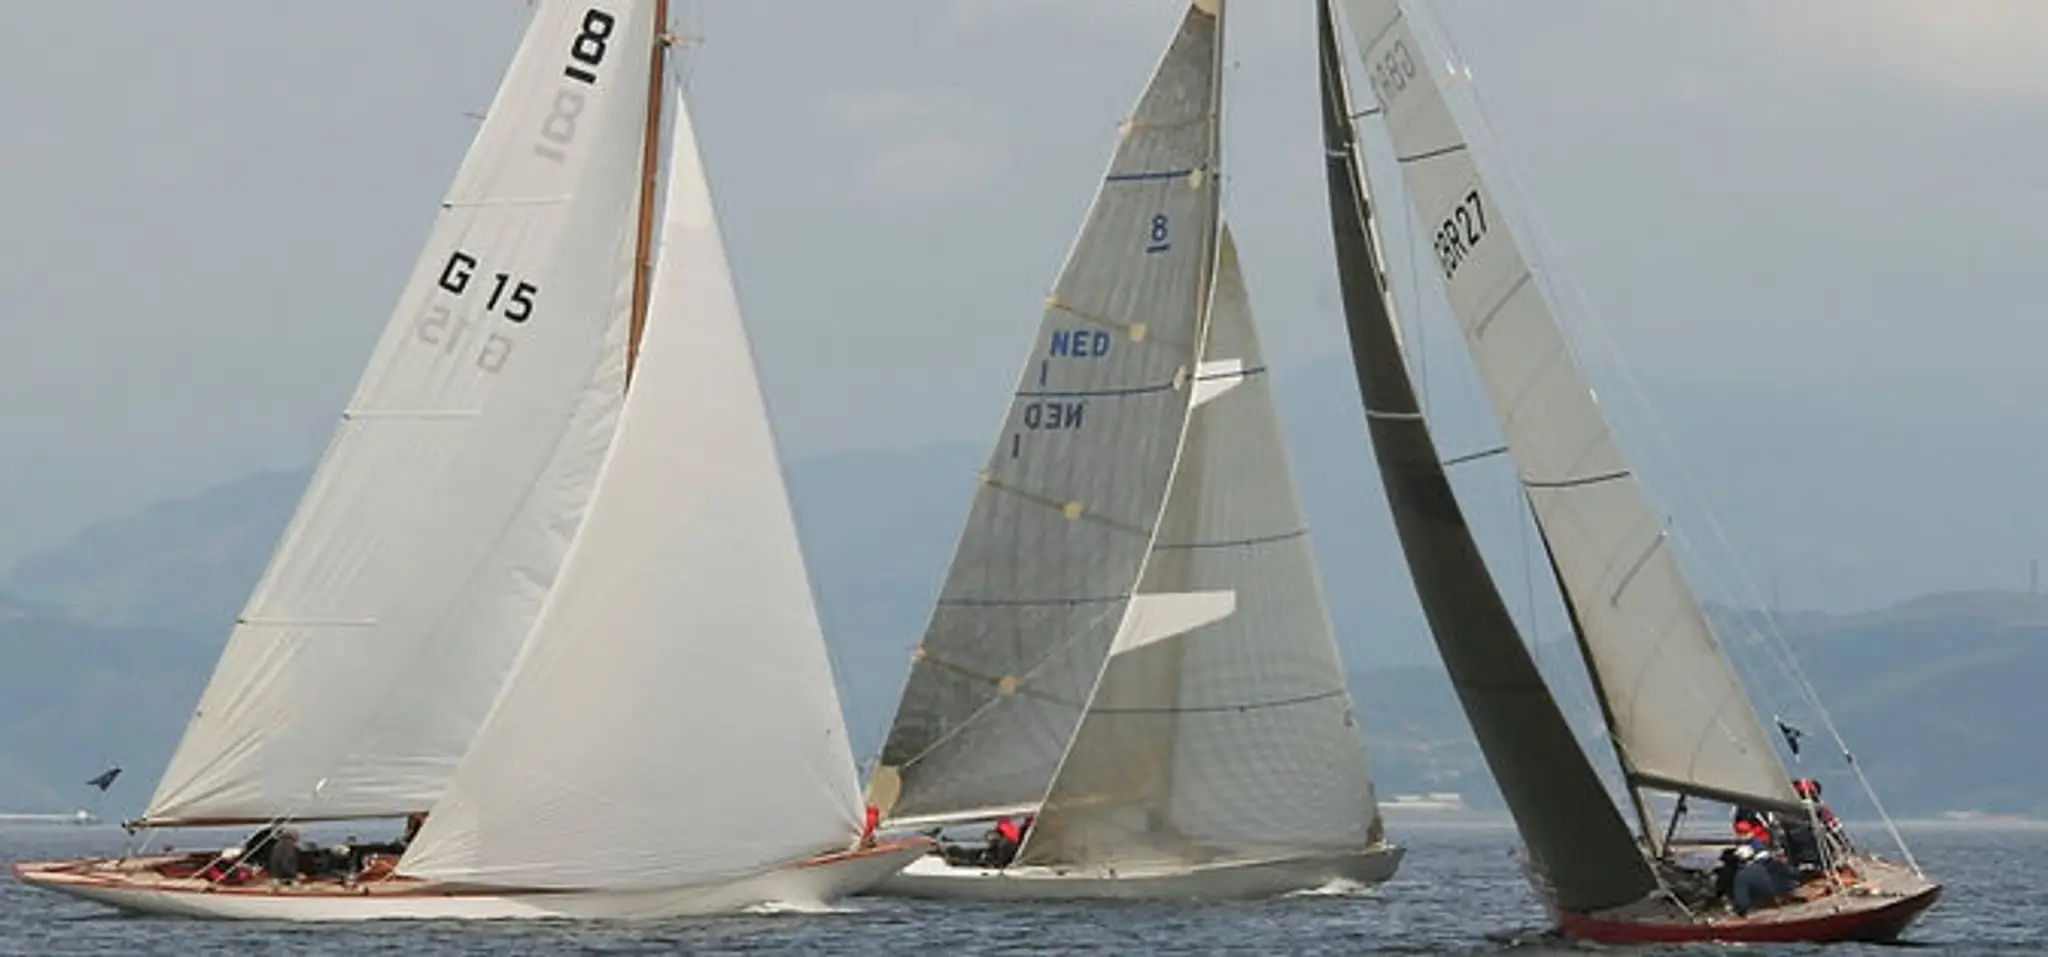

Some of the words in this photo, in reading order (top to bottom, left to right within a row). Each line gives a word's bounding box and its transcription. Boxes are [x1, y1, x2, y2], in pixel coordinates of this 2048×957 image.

[1150, 213, 1169, 243] 8
[438, 251, 477, 294] G
[486, 273, 538, 323] 15
[1049, 331, 1110, 357] NED
